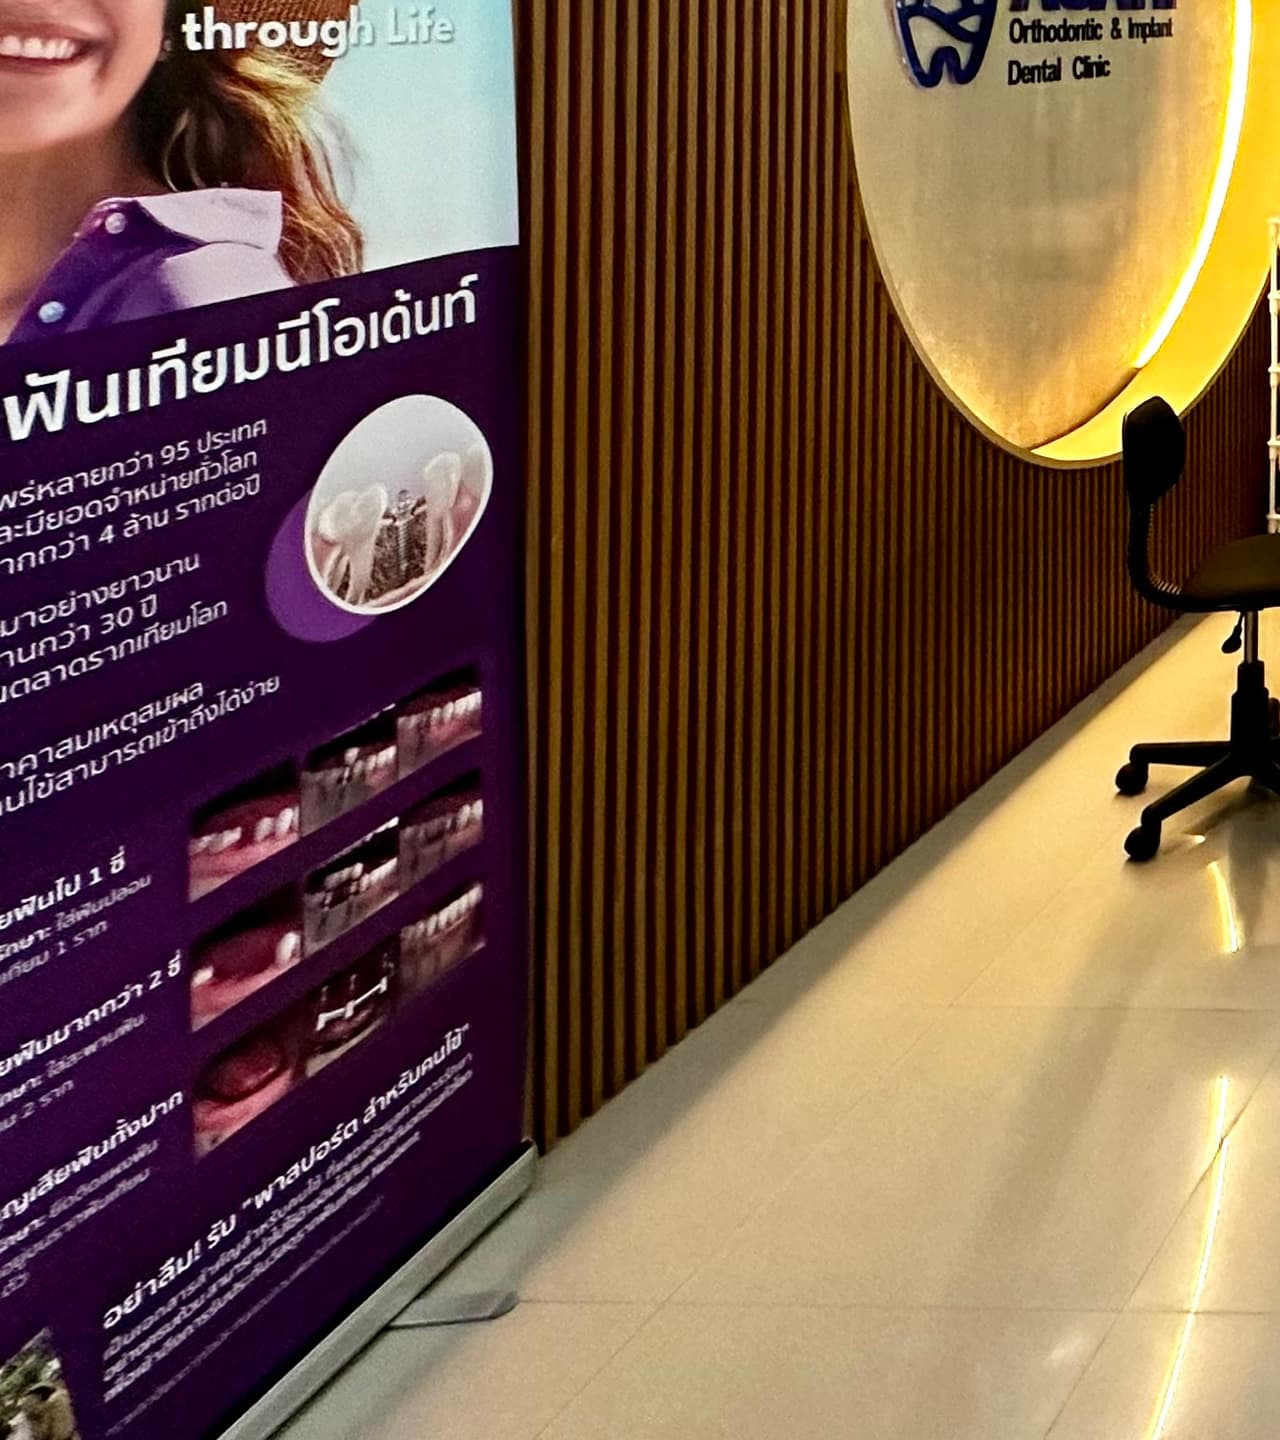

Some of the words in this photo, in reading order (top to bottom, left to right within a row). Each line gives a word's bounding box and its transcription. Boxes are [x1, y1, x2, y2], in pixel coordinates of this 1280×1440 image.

[181, 5, 375, 58] through
[387, 6, 456, 44] Life
[1009, 17, 1103, 44] Orthodontic
[1111, 17, 1122, 40] &
[1128, 17, 1173, 44] Implant
[1008, 57, 1062, 85] Dental
[1072, 54, 1111, 80] Clinic
[3, 274, 479, 441] ฟันเทียมนีโอเด้นท์
[160, 440, 190, 465] 95
[197, 419, 268, 453] ประเทศ
[98, 524, 115, 544] 4
[123, 508, 170, 538] ล้าน
[175, 473, 261, 520] รากต่อปี
[100, 606, 133, 635] 30
[140, 593, 158, 618] ปี
[0, 675, 281, 816] นไข้สามารถเข้าถึงได้ง่าย
[89, 866, 103, 886] 1
[56, 941, 68, 956] 1
[149, 970, 163, 990] 2
[22, 1101, 36, 1119] 2
[103, 1239, 201, 1330] อย่าลืม!
[206, 1213, 236, 1249] รับ
